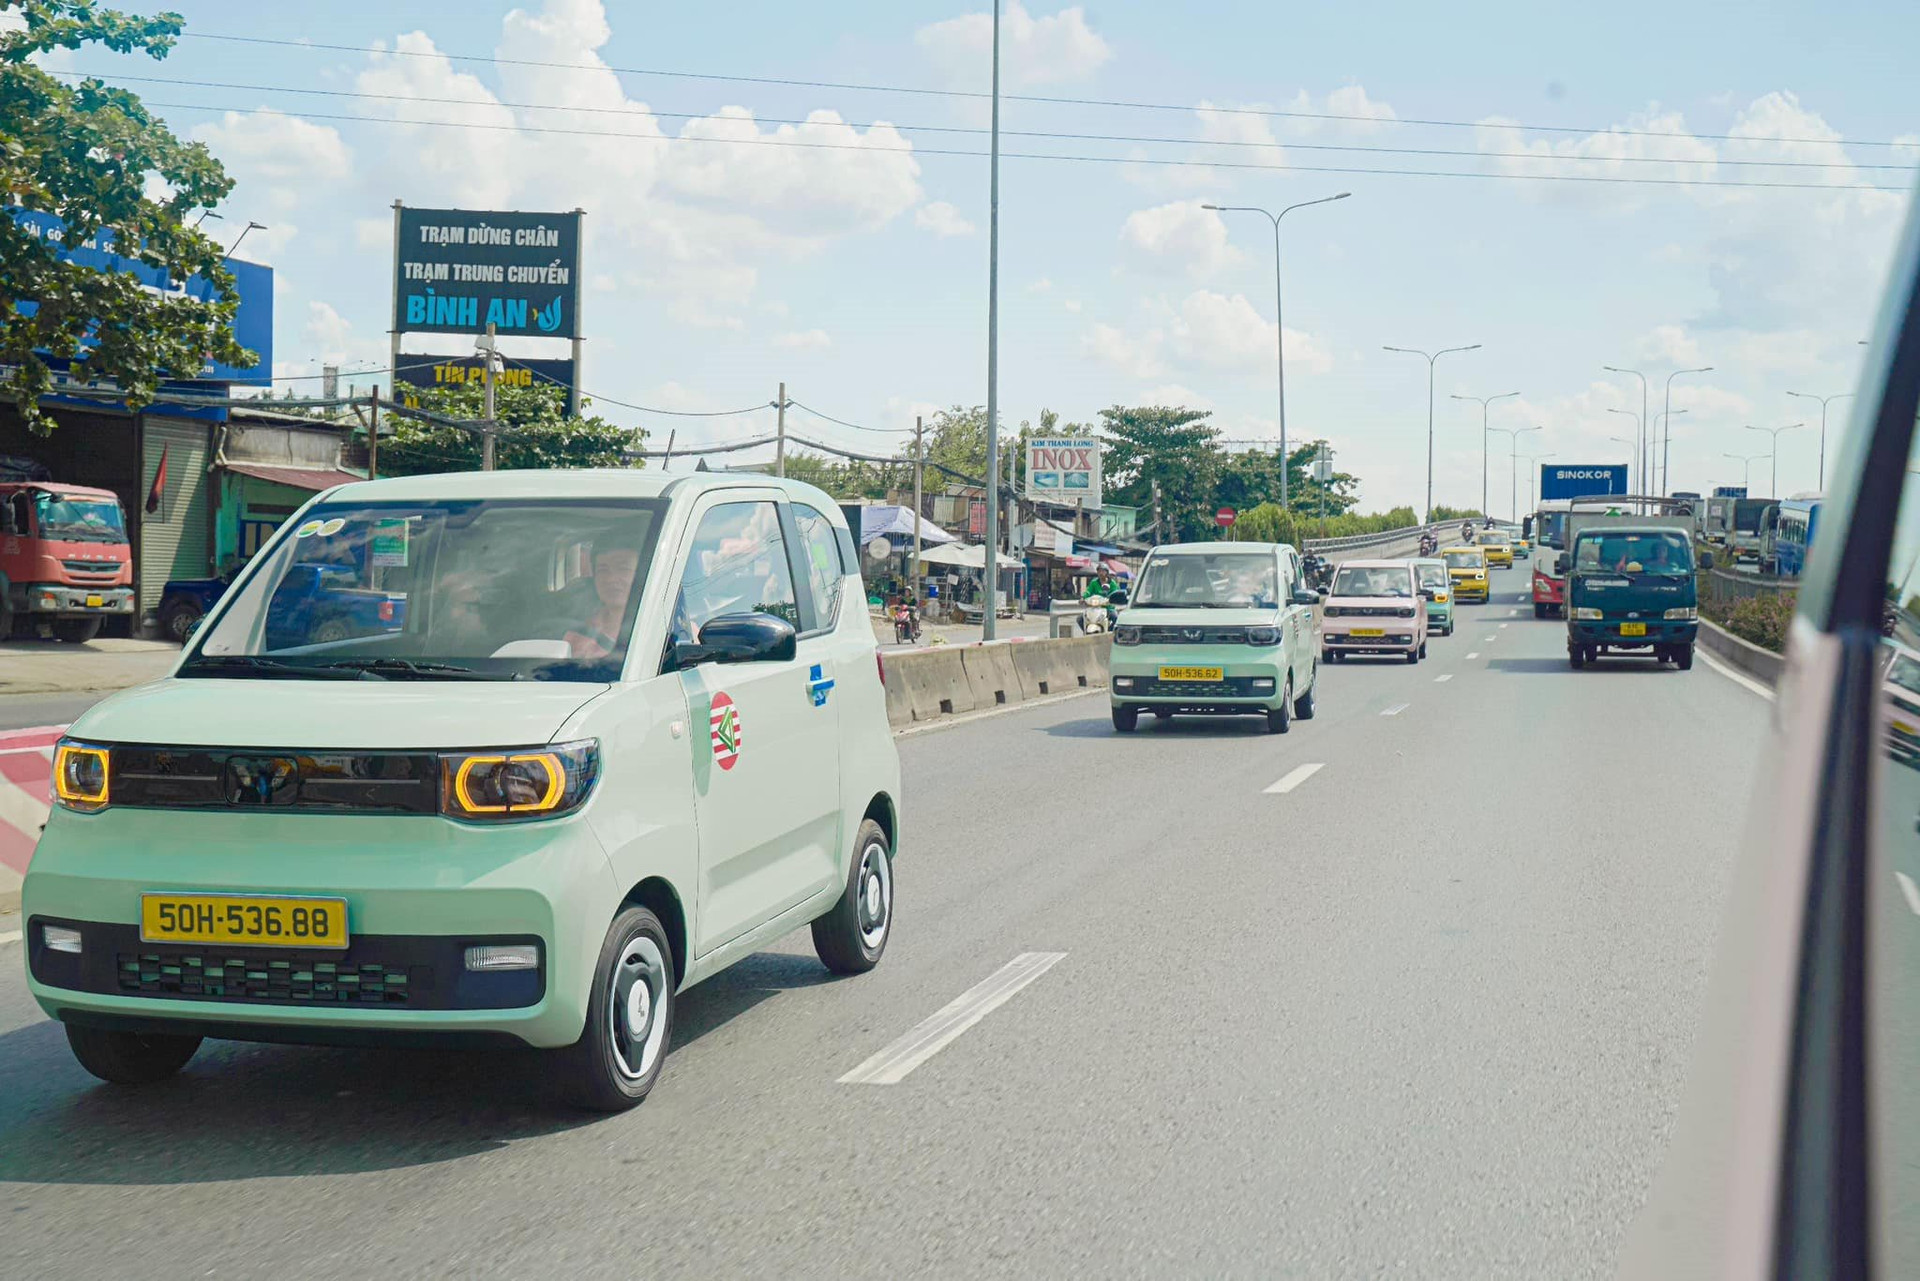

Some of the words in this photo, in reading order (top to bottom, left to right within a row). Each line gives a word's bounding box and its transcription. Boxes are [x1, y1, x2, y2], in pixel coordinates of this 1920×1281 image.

[47, 226, 64, 241] GÒ
[420, 225, 464, 247] TRẠM
[468, 222, 511, 246] DỪNG
[515, 225, 559, 248] CHÂN
[404, 262, 449, 284] TRẠM
[453, 264, 504, 283] TRUNG
[507, 258, 570, 285] CHUYỂN
[406, 287, 479, 327] BÌNH
[485, 298, 529, 329] AN
[434, 361, 466, 384] TÍN
[1031, 448, 1093, 471] INOX
[1556, 470, 1613, 480] SINOKOR
[159, 903, 329, 938] 50H-536.88
